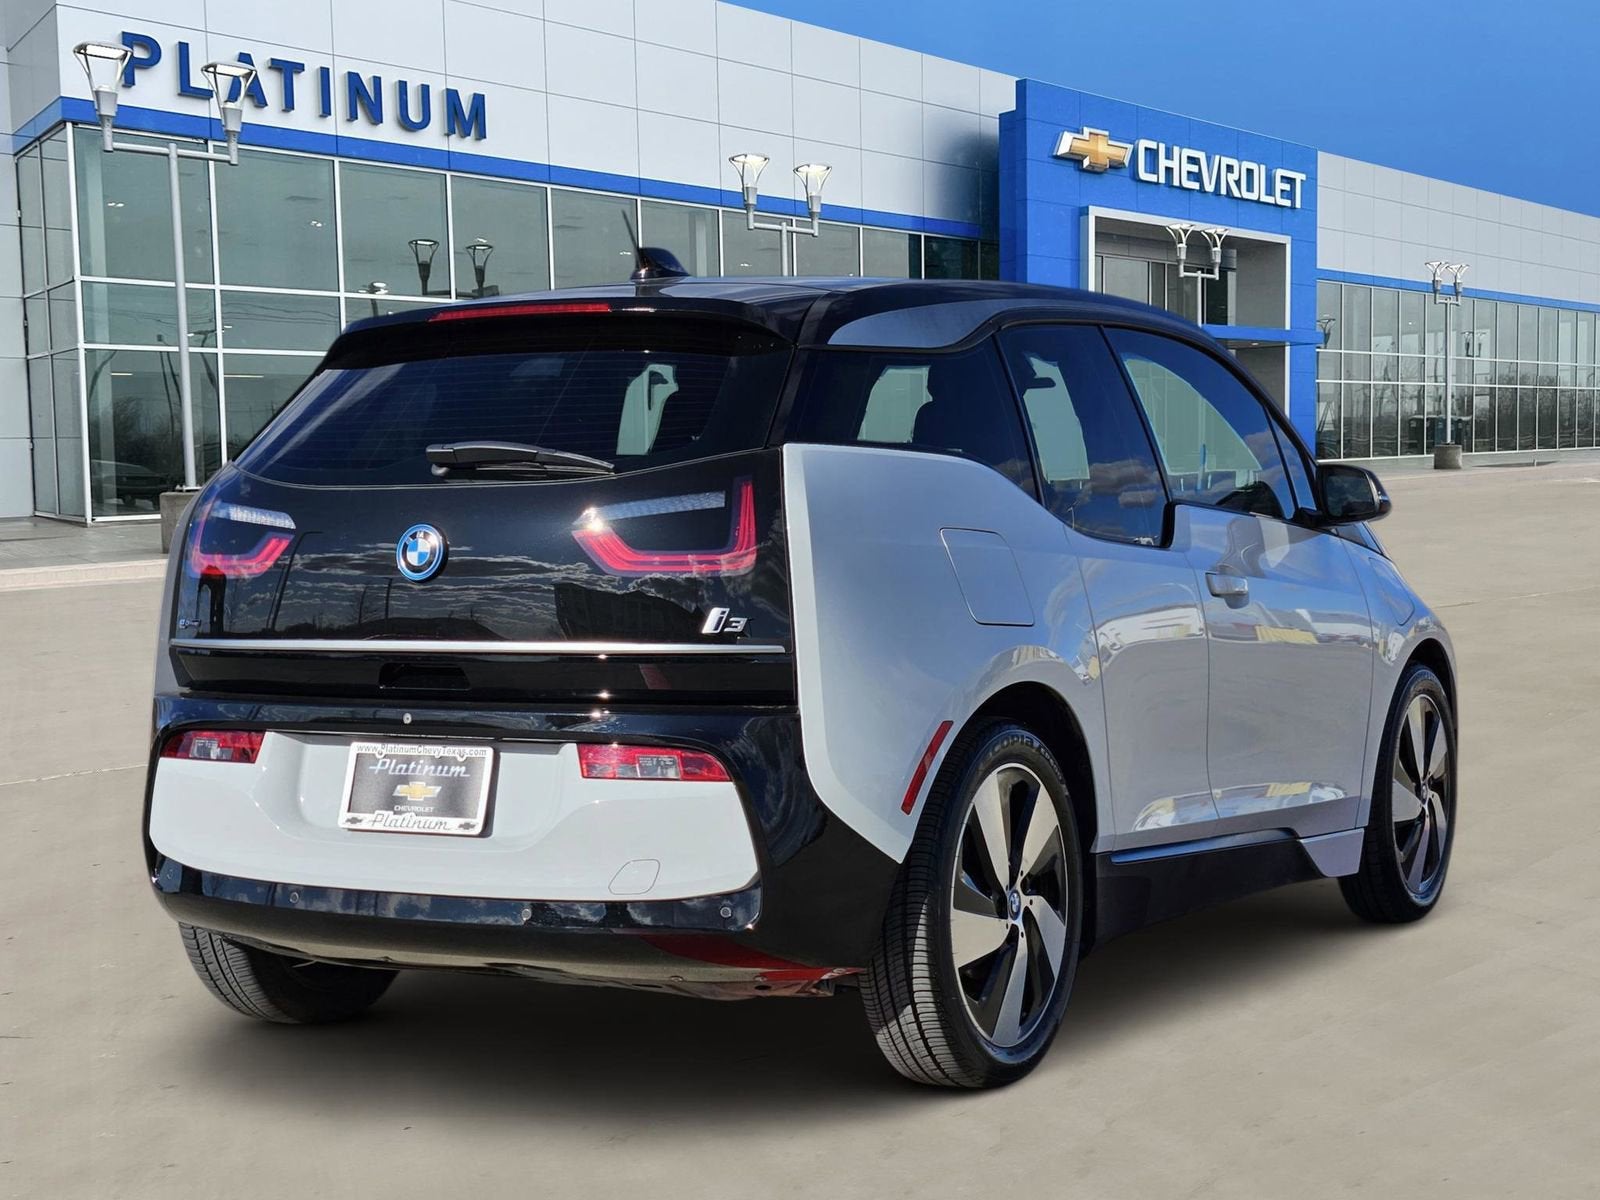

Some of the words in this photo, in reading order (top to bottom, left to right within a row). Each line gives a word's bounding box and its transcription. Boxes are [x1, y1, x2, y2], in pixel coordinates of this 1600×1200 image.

[121, 31, 487, 139] PLATINUM
[1137, 139, 1306, 209] CHEVROLET
[702, 607, 748, 634] i3
[356, 743, 487, 757] www.PlatinumChevyTexas.com
[369, 758, 471, 778] Platinum
[394, 805, 434, 813] CHEVROLET
[367, 813, 452, 832] Platinum
